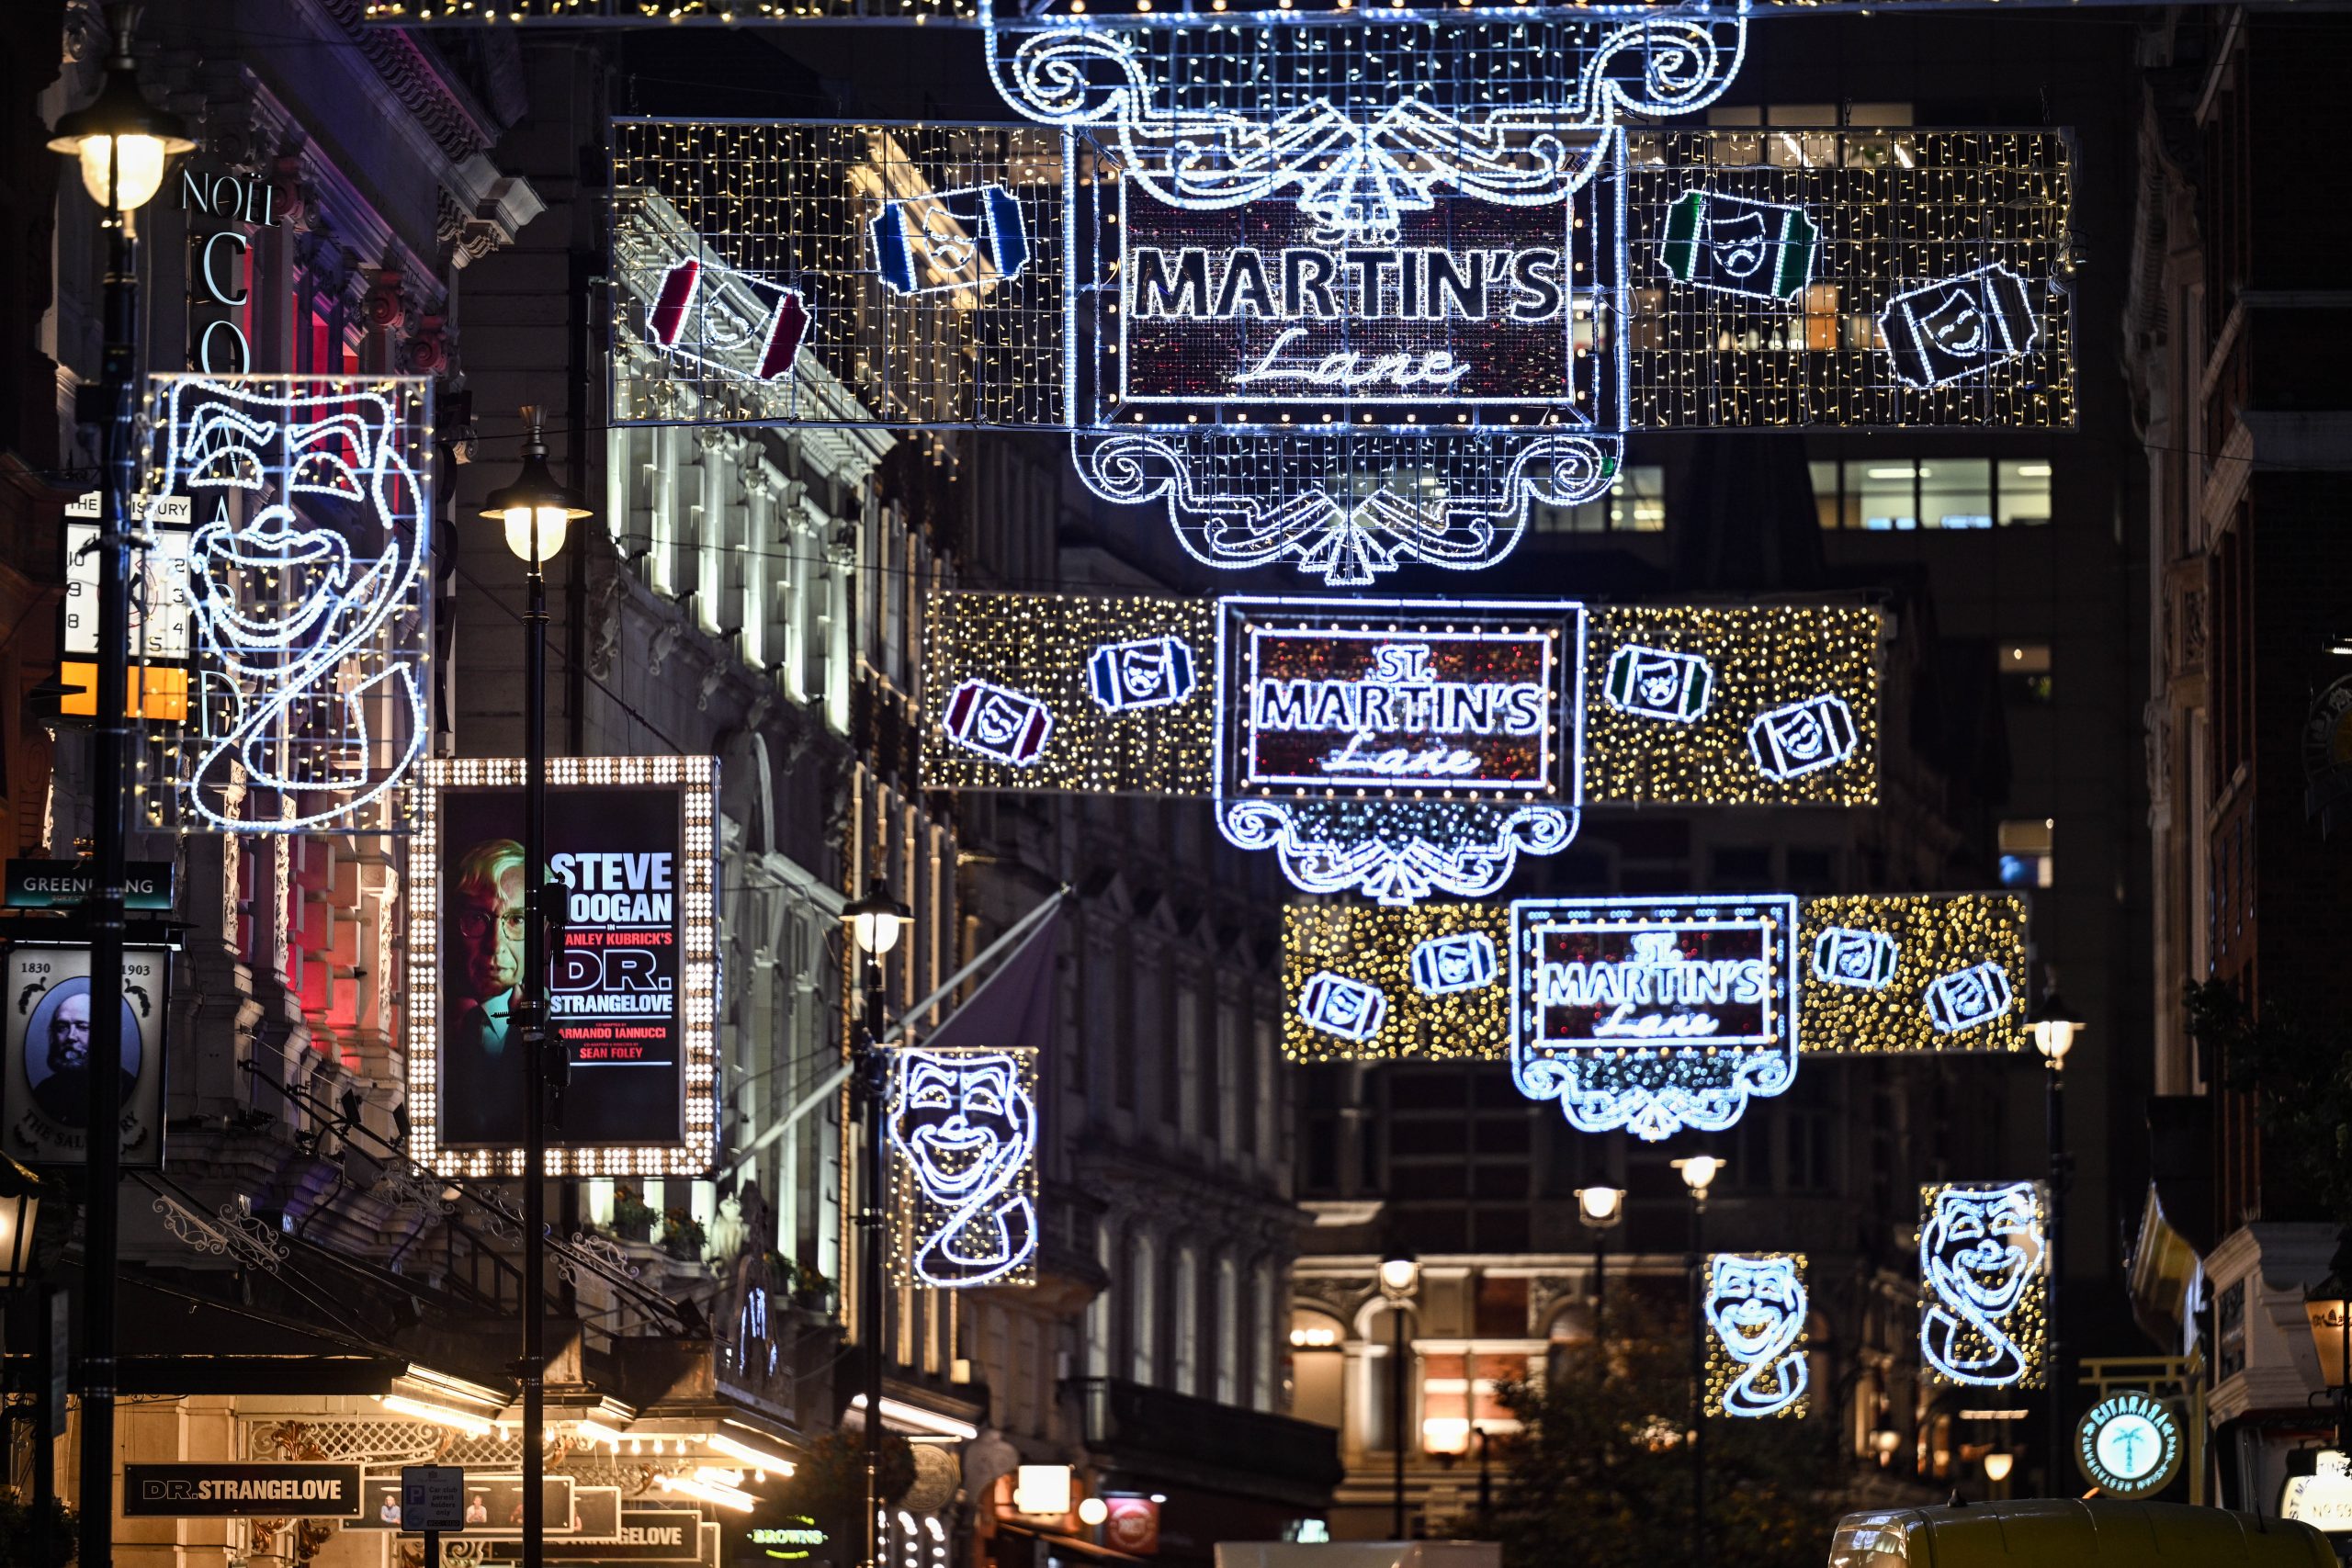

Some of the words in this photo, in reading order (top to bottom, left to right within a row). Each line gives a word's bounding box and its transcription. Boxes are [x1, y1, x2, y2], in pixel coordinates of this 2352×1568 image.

[1132, 247, 1564, 322] MARTIN'S
[1233, 328, 1471, 385] Lane
[1375, 644, 1437, 682] ST.
[1258, 679, 1543, 736] MARTIN'S
[1321, 728, 1482, 775] Lane
[550, 852, 673, 891] STEVE
[570, 893, 673, 923] OOGAN
[606, 932, 673, 945] KUBRICK'S
[21, 963, 51, 974] 1830
[550, 949, 673, 992] DR.
[1544, 959, 1764, 1006] MARTIN'S
[550, 995, 673, 1012] STRANGELOVE
[1593, 1002, 1720, 1037] Lane
[615, 1027, 666, 1039] IANNUCCI
[579, 1047, 607, 1059] SEAN
[611, 1047, 643, 1058] FOLEY
[23, 1109, 52, 1140] THE
[752, 1529, 823, 1545] BROWNS
